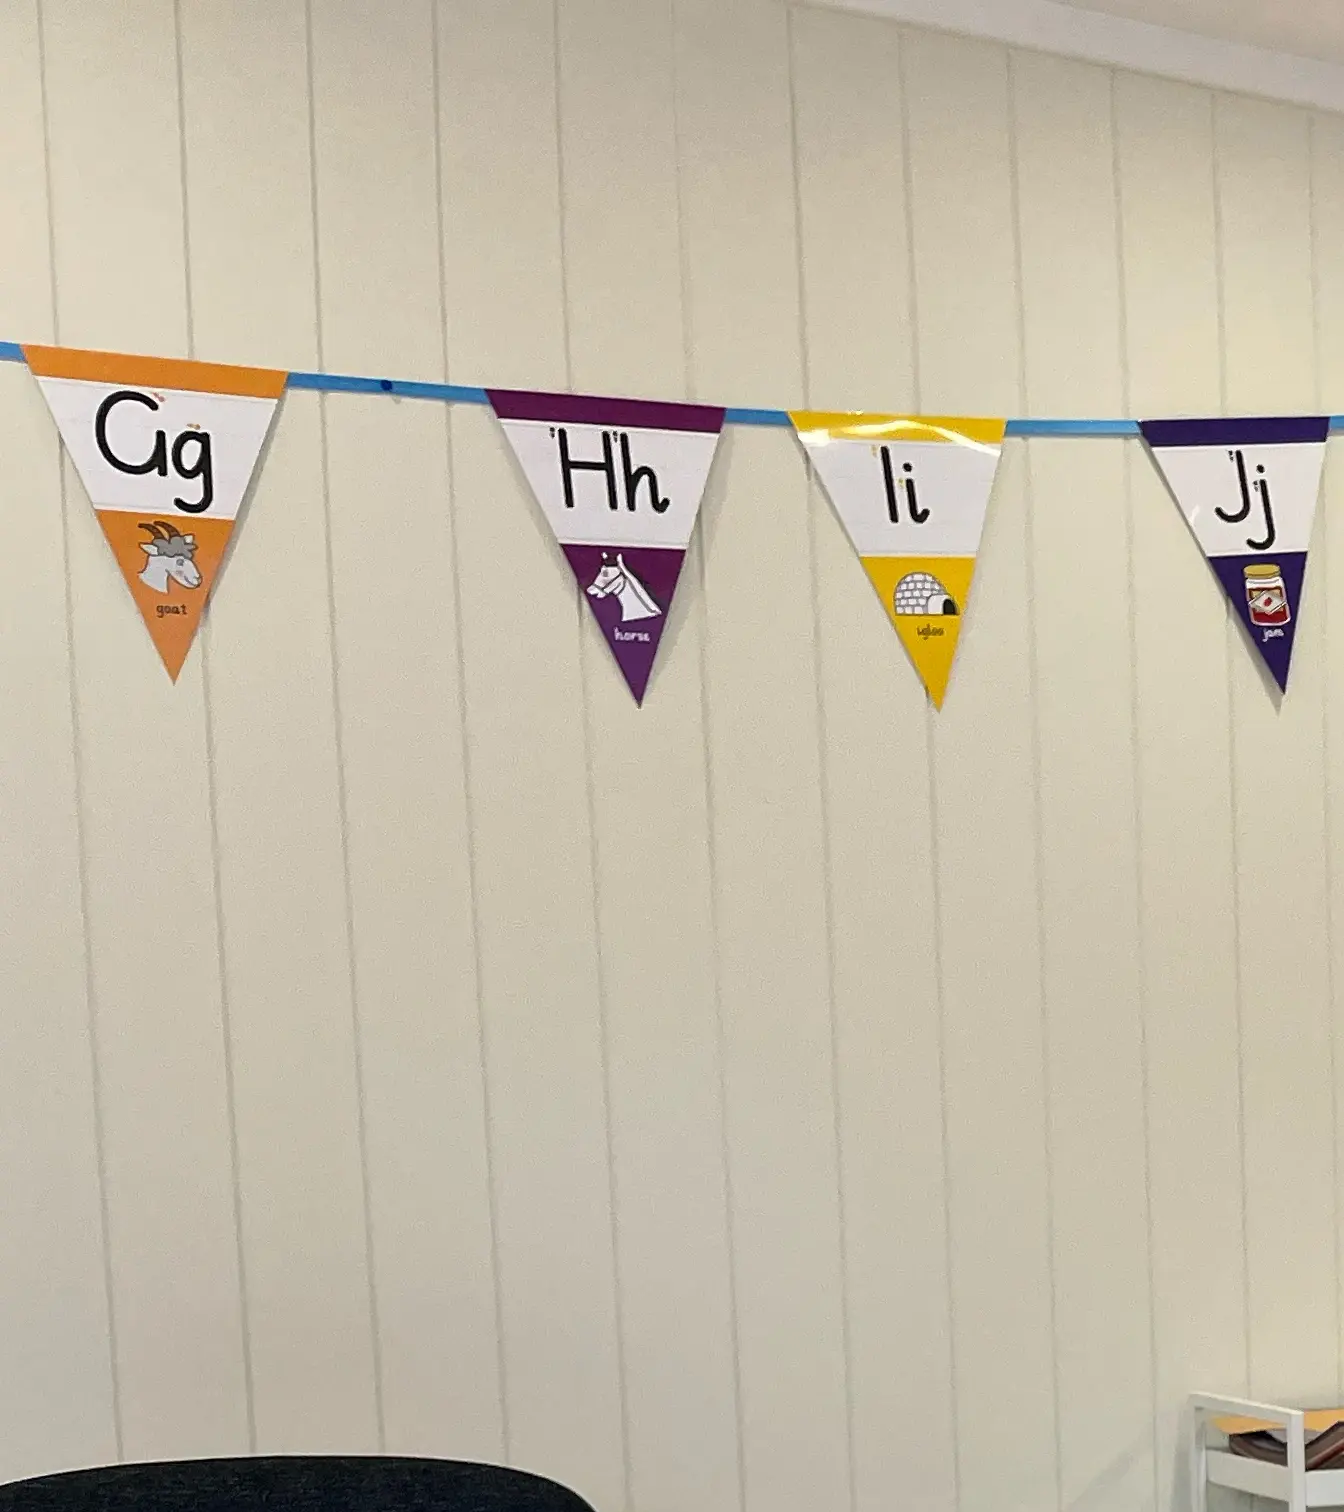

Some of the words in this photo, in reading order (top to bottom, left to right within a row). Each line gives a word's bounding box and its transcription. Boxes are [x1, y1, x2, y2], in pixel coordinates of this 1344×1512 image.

[95, 390, 213, 514] Gg
[557, 428, 670, 514] Hh
[880, 446, 930, 525] Ii
[1215, 450, 1276, 550] Jj
[156, 603, 188, 618] goat
[614, 628, 651, 645] horse
